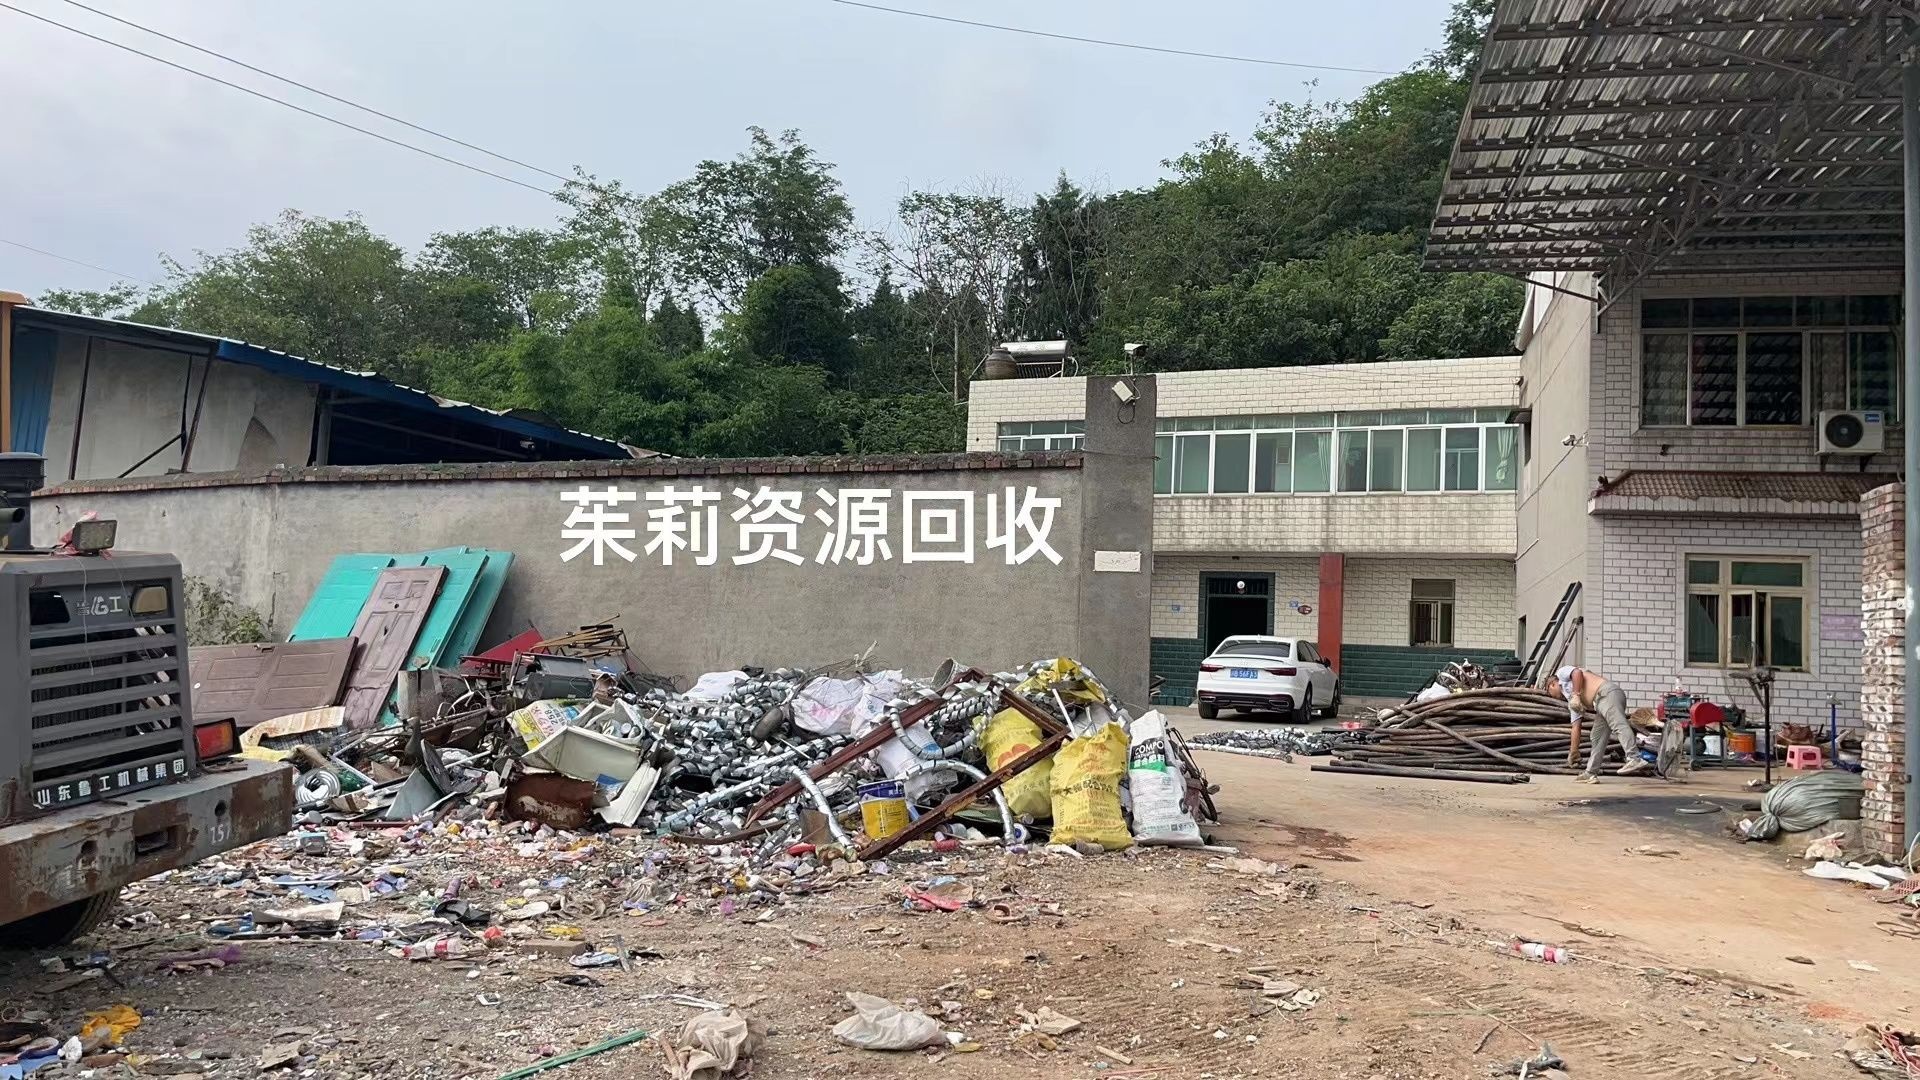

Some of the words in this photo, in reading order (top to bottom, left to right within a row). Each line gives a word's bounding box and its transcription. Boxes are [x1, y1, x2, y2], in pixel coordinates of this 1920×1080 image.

[1134, 740, 1164, 756] COMPO
[37, 758, 185, 806] 山东鲁工机械集团
